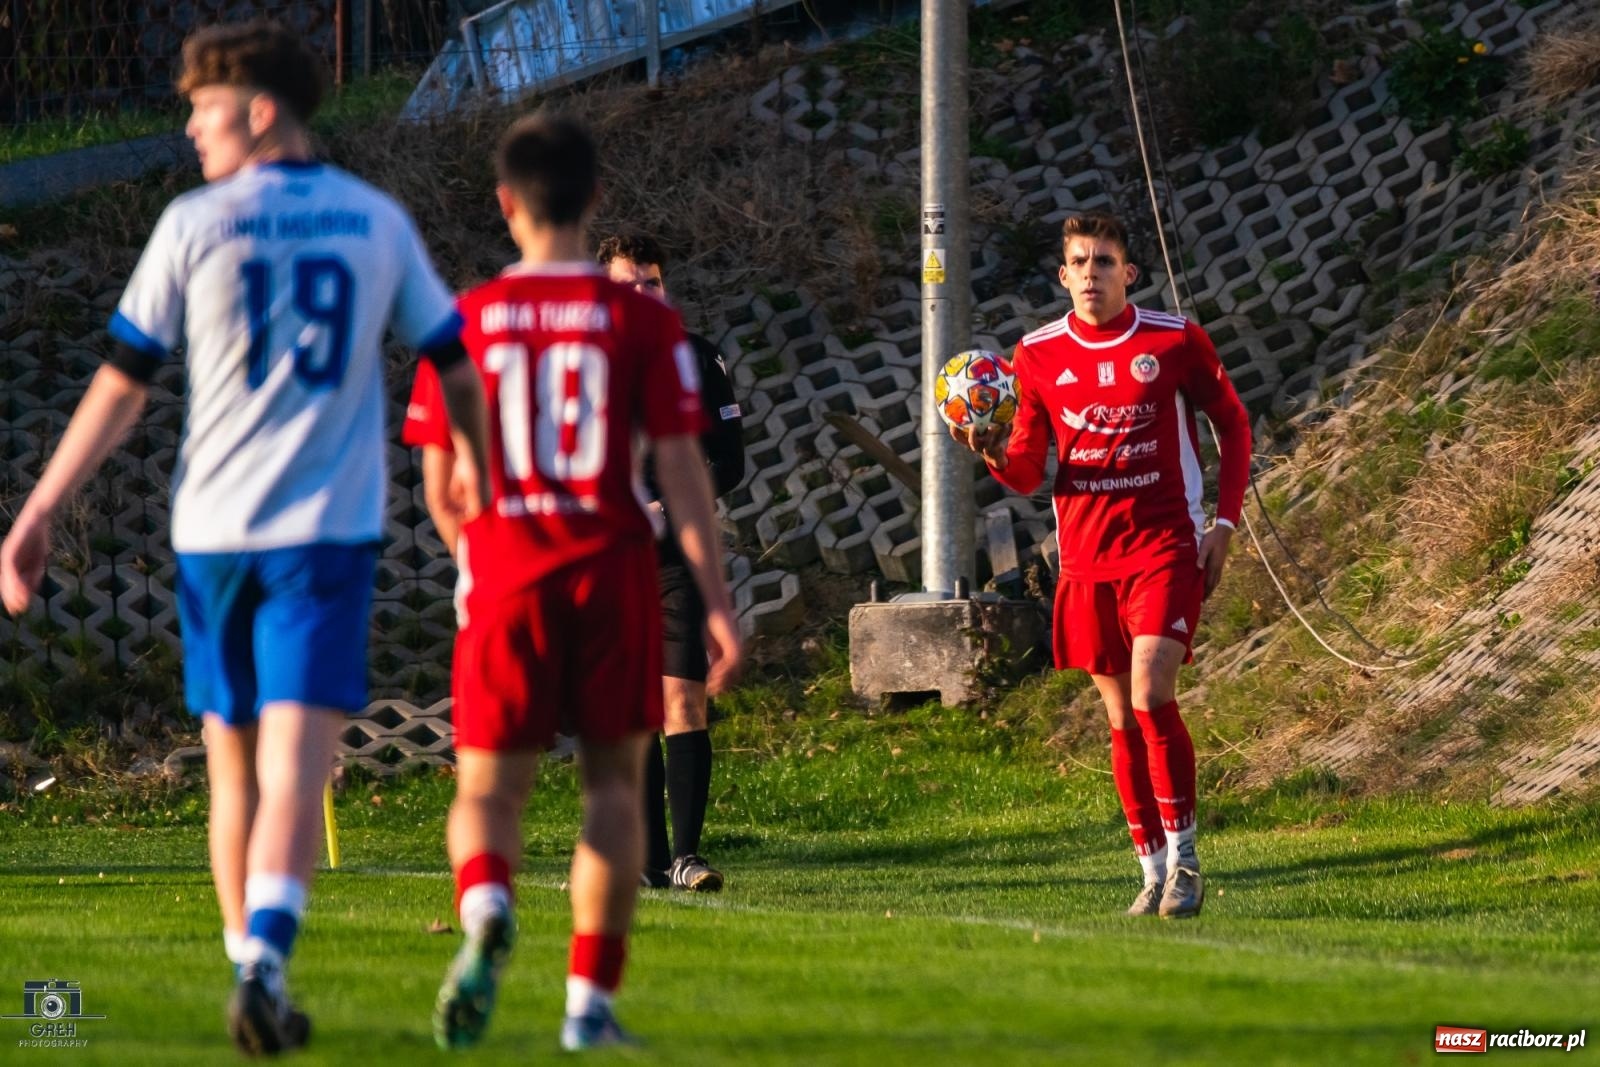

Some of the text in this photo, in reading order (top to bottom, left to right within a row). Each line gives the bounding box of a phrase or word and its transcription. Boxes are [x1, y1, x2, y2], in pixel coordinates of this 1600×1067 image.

[241, 256, 355, 390] 19
[484, 342, 609, 481] 18
[1089, 471, 1161, 493] WENINGER
